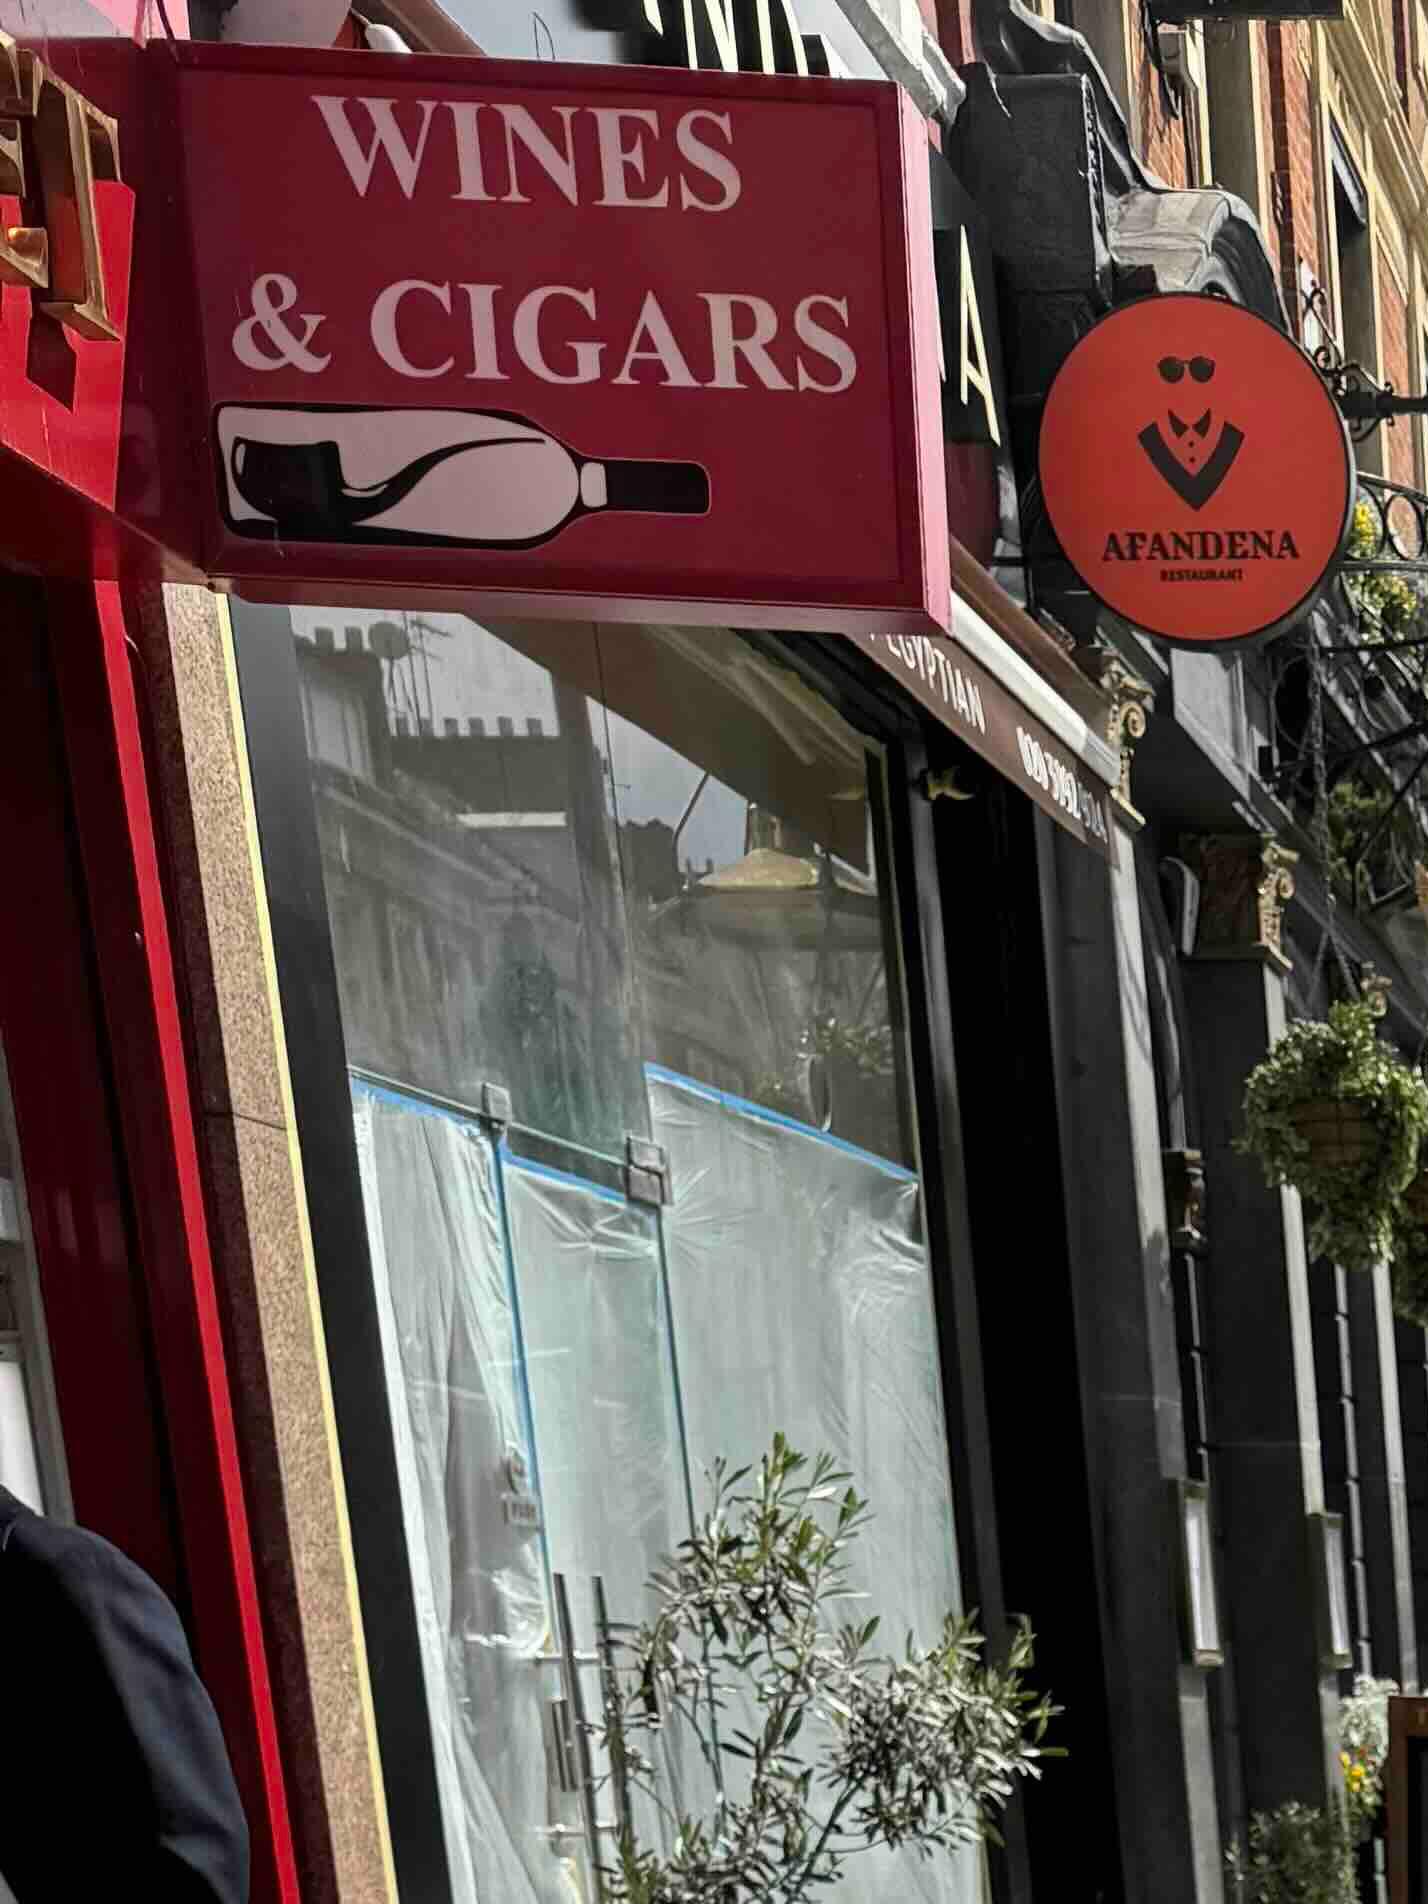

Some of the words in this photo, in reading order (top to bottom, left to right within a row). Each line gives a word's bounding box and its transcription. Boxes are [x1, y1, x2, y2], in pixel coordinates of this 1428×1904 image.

[311, 95, 743, 212] WINES
[231, 273, 332, 374] &
[370, 279, 858, 393] CIGARS
[1101, 530, 1300, 561] AFANDENA
[1159, 568, 1243, 582] RESTAURANT
